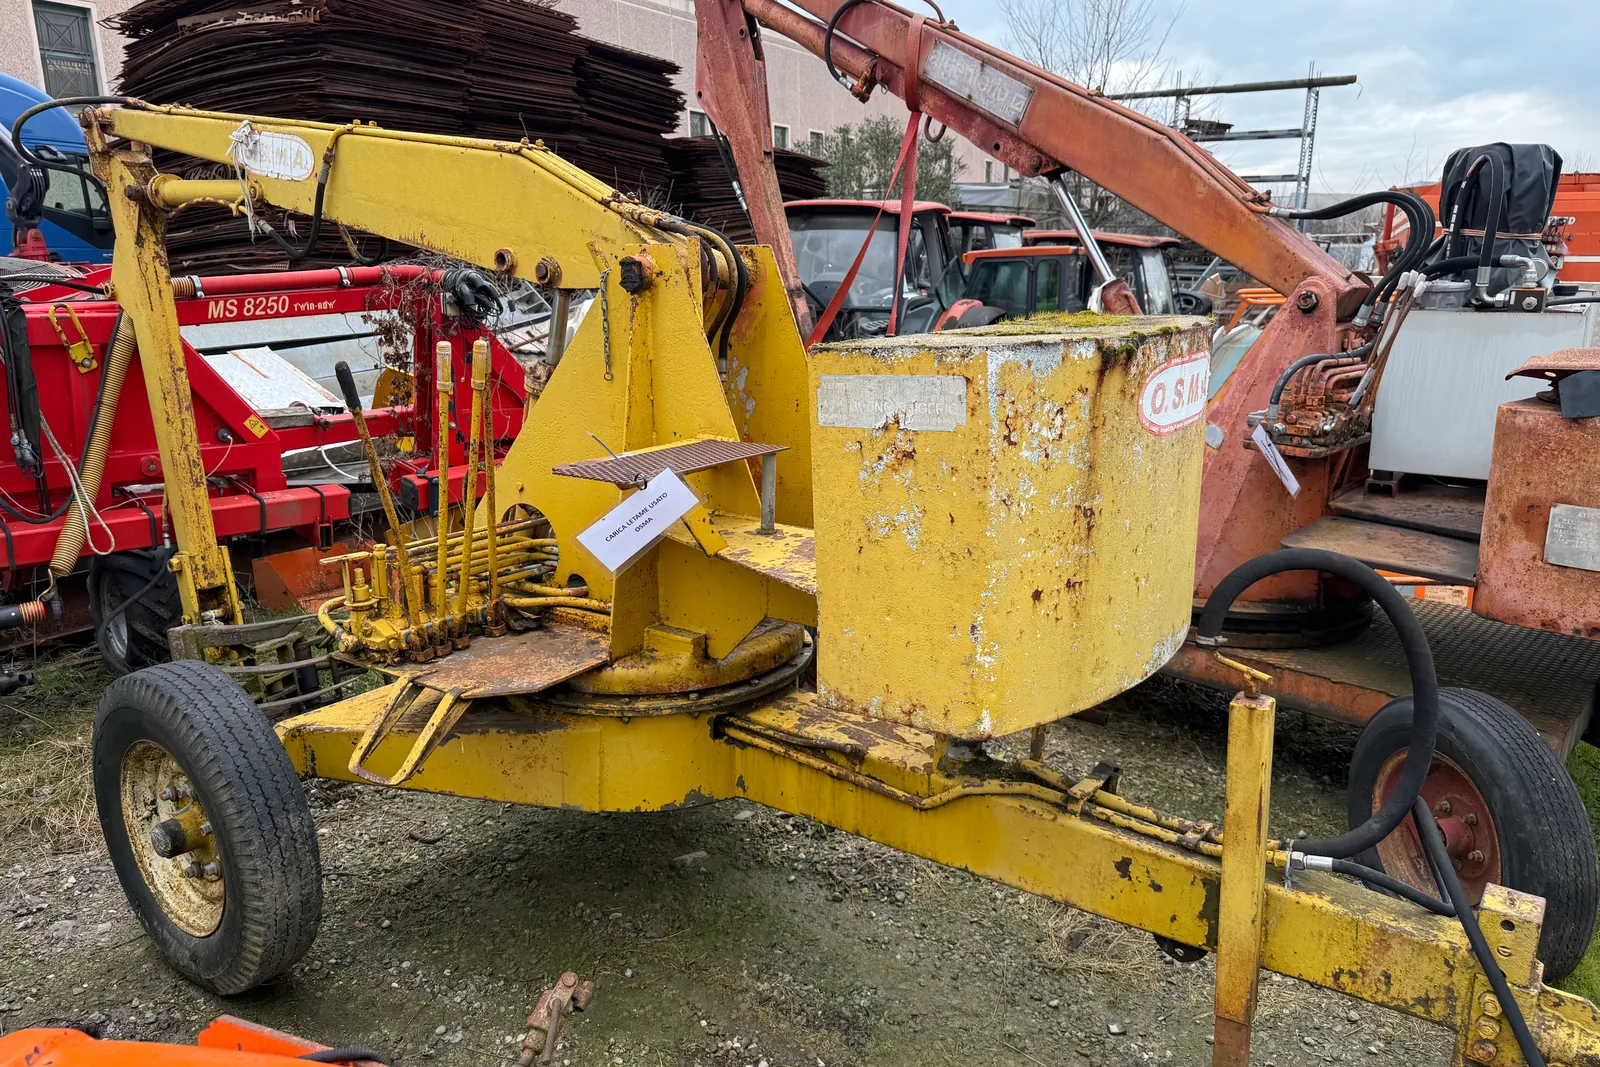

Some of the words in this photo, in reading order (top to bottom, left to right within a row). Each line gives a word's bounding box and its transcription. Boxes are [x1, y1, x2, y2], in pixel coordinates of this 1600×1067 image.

[208, 299, 238, 319] MS
[243, 295, 289, 317] 8250
[605, 524, 628, 542] CARICA
[626, 507, 650, 527] LETAME
[648, 492, 668, 509] USATO
[634, 517, 654, 533] OSMA
